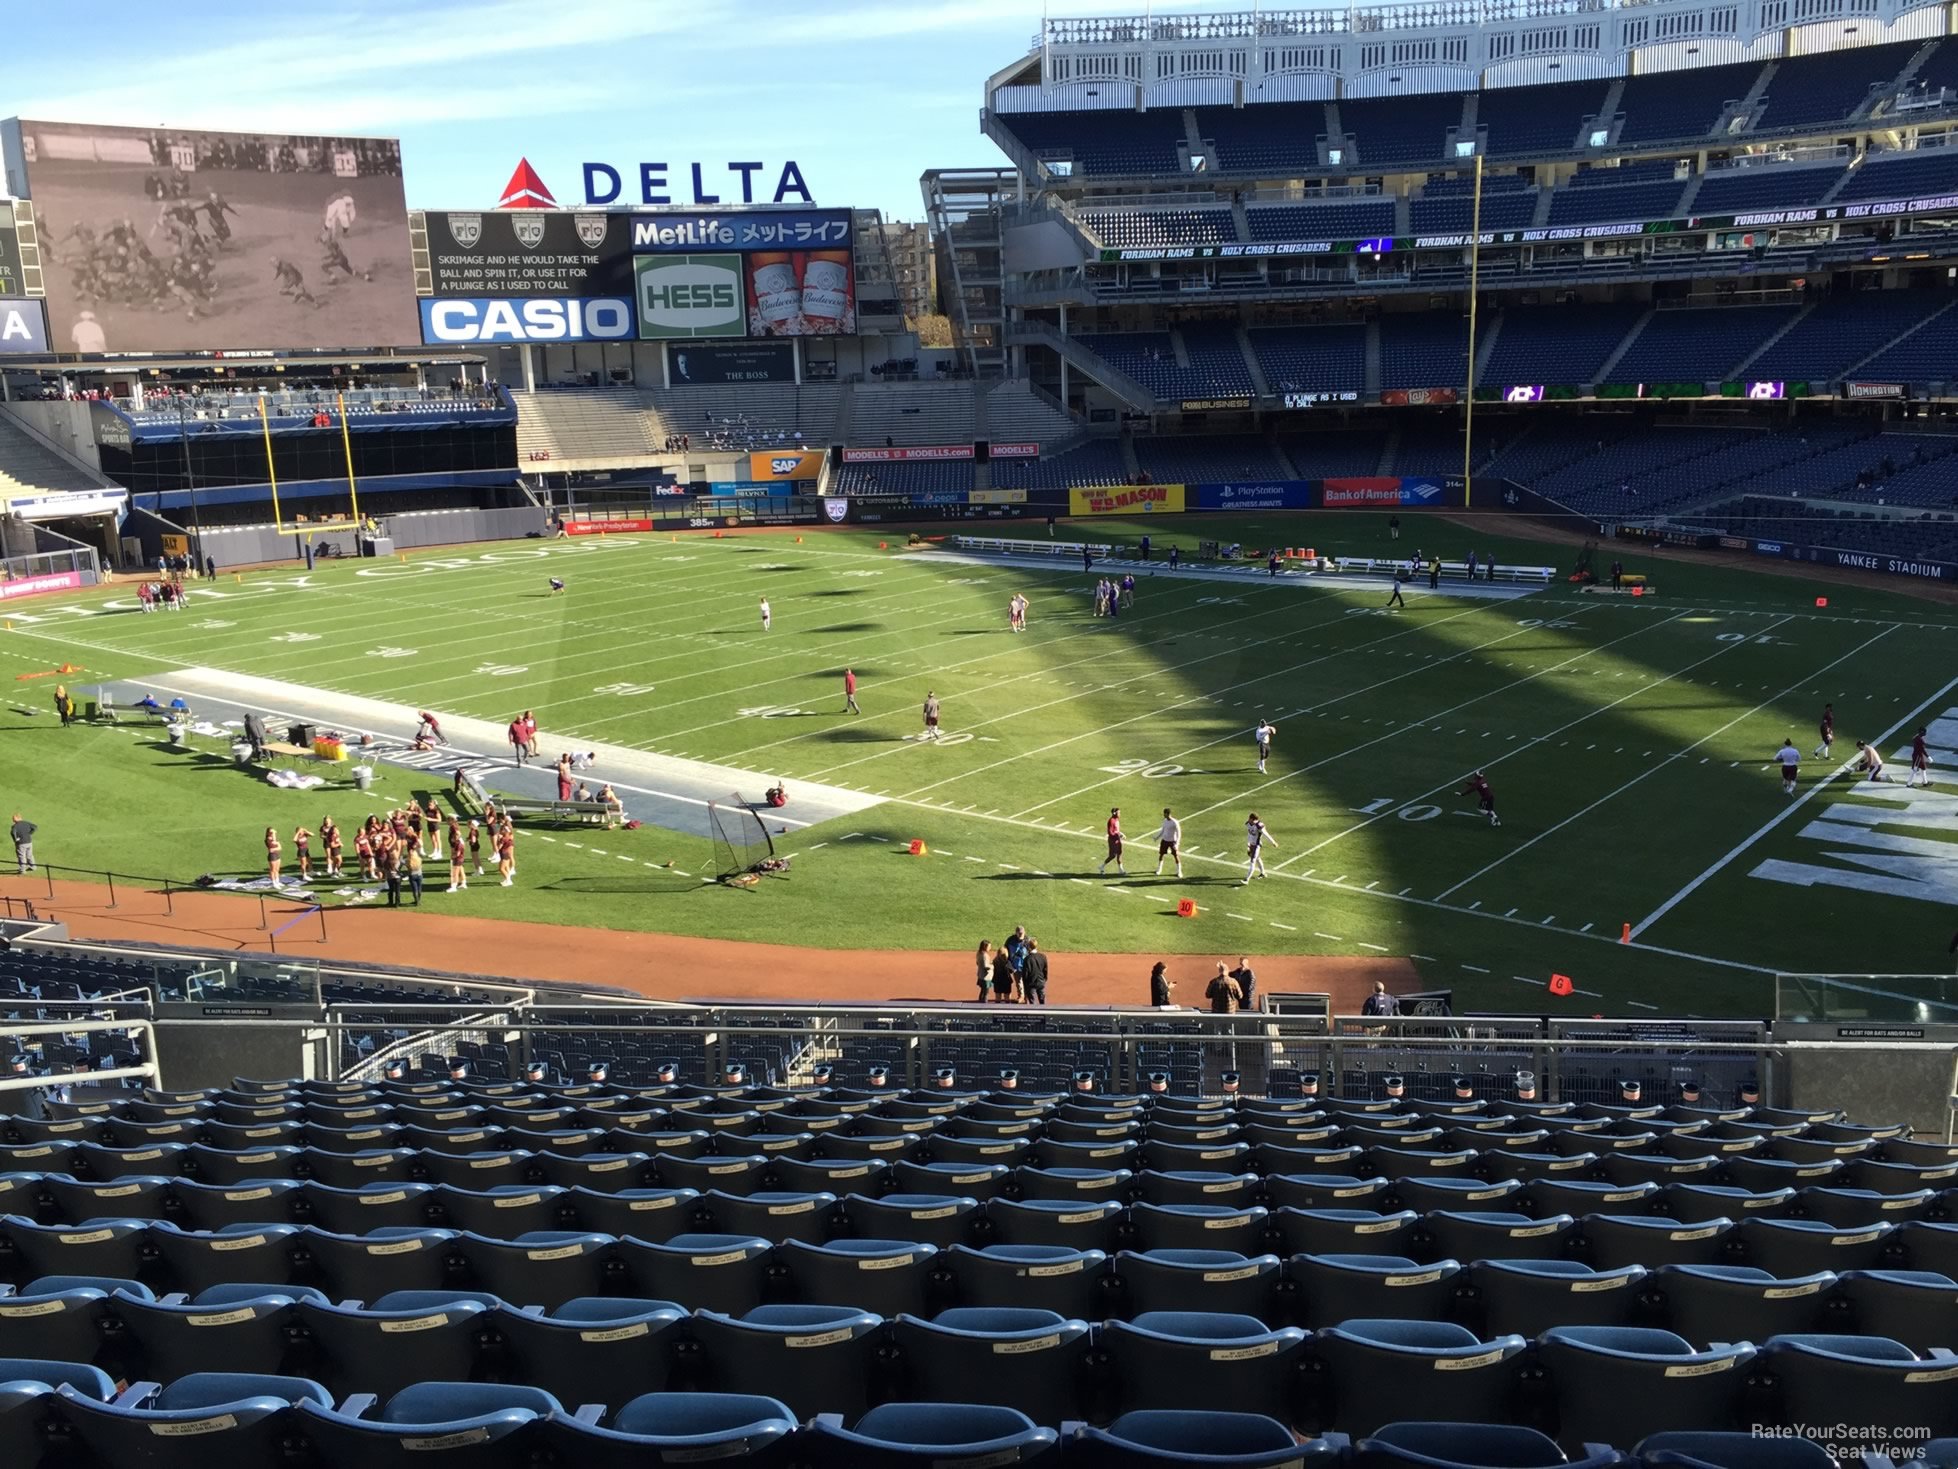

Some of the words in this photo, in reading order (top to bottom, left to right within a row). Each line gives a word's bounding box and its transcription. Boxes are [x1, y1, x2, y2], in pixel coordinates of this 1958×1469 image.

[582, 161, 812, 205] DELTA
[1845, 205, 1871, 217] HOLY
[1872, 202, 1908, 215] CROSS
[1733, 212, 1785, 226] FORDHAM
[1786, 210, 1818, 222] RAMS
[634, 219, 735, 246] MetLife
[742, 221, 849, 243] メットライフ
[1522, 230, 1549, 241] HOLY
[1549, 228, 1583, 239] CROSS
[1583, 224, 1644, 237] CRUSADERS
[1415, 236, 1463, 247] FORDHAM
[1120, 249, 1165, 260] FORDHAM
[1167, 248, 1195, 258] RAMS
[1220, 246, 1244, 256] HOLY
[1245, 245, 1275, 255] CROSS
[1276, 243, 1332, 254] CRUSADERS
[438, 256, 484, 264] SKRIMAGE
[487, 256, 506, 264] AND
[508, 256, 520, 264] HE
[522, 256, 555, 264] WOULD
[556, 256, 579, 264] TAKE
[581, 256, 600, 264] THE
[440, 269, 461, 278] BALL
[464, 269, 483, 278] AND
[484, 269, 506, 277] SPIN
[508, 269, 520, 279] IT,
[523, 269, 536, 277] OR
[538, 269, 555, 277] USE
[557, 269, 567, 277] IT
[569, 269, 588, 277] FOR
[441, 282, 448, 290] A
[450, 282, 485, 290] PLUNGE
[487, 281, 498, 290] AS
[500, 282, 505, 290] I
[507, 281, 531, 290] USED
[533, 281, 546, 289] TO
[548, 281, 568, 290] CALL
[646, 284, 735, 309] HESS
[2, 310, 32, 339] A
[431, 299, 630, 341] CASIO
[725, 372, 744, 380] THE
[746, 371, 769, 380] BOSS
[1849, 383, 1901, 397] ADMIRATION
[1201, 399, 1250, 409] BUSINESS
[1293, 394, 1318, 402] PLUNGE
[847, 450, 890, 460] MODELL'S
[906, 448, 970, 458] MODELLS.com
[993, 446, 1034, 455] MODELL'S
[772, 459, 797, 475] SAP
[656, 485, 685, 496] FedEx
[1238, 486, 1284, 497] PlayStation
[1326, 489, 1353, 501] Bank
[1353, 489, 1365, 499] of
[1365, 488, 1411, 499] America
[1222, 501, 1258, 509] GREATNESS
[1259, 499, 1283, 508] AWAITS
[1758, 543, 1781, 552] GEICO
[354, 538, 640, 577] CROSS
[1838, 553, 1878, 569] YANKEE
[1889, 560, 1941, 578] STADIUM
[1097, 757, 1184, 779] 20
[1348, 798, 1443, 822] 10
[1180, 901, 1191, 913] 10
[1555, 977, 1565, 990] G
